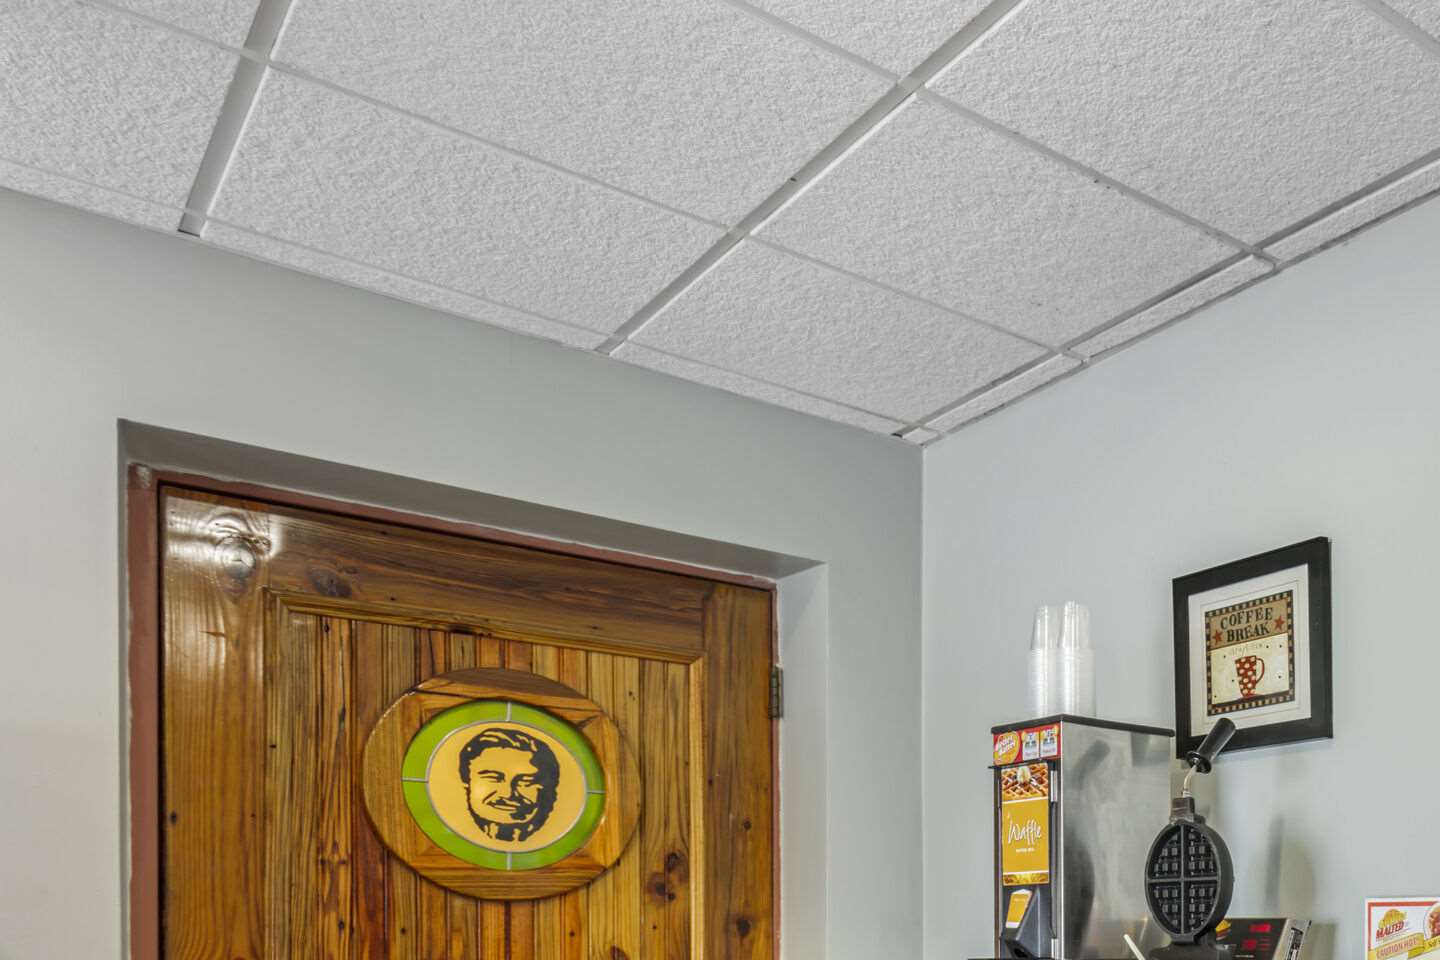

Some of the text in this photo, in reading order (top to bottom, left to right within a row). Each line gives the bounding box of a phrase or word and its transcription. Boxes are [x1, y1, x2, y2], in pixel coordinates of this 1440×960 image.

[1220, 607, 1273, 630] COFFEE
[1226, 622, 1270, 642] BREAK
[1007, 818, 1042, 846] Waffle
[1375, 920, 1405, 939] MALTED
[1375, 941, 1403, 960] CAUTION
